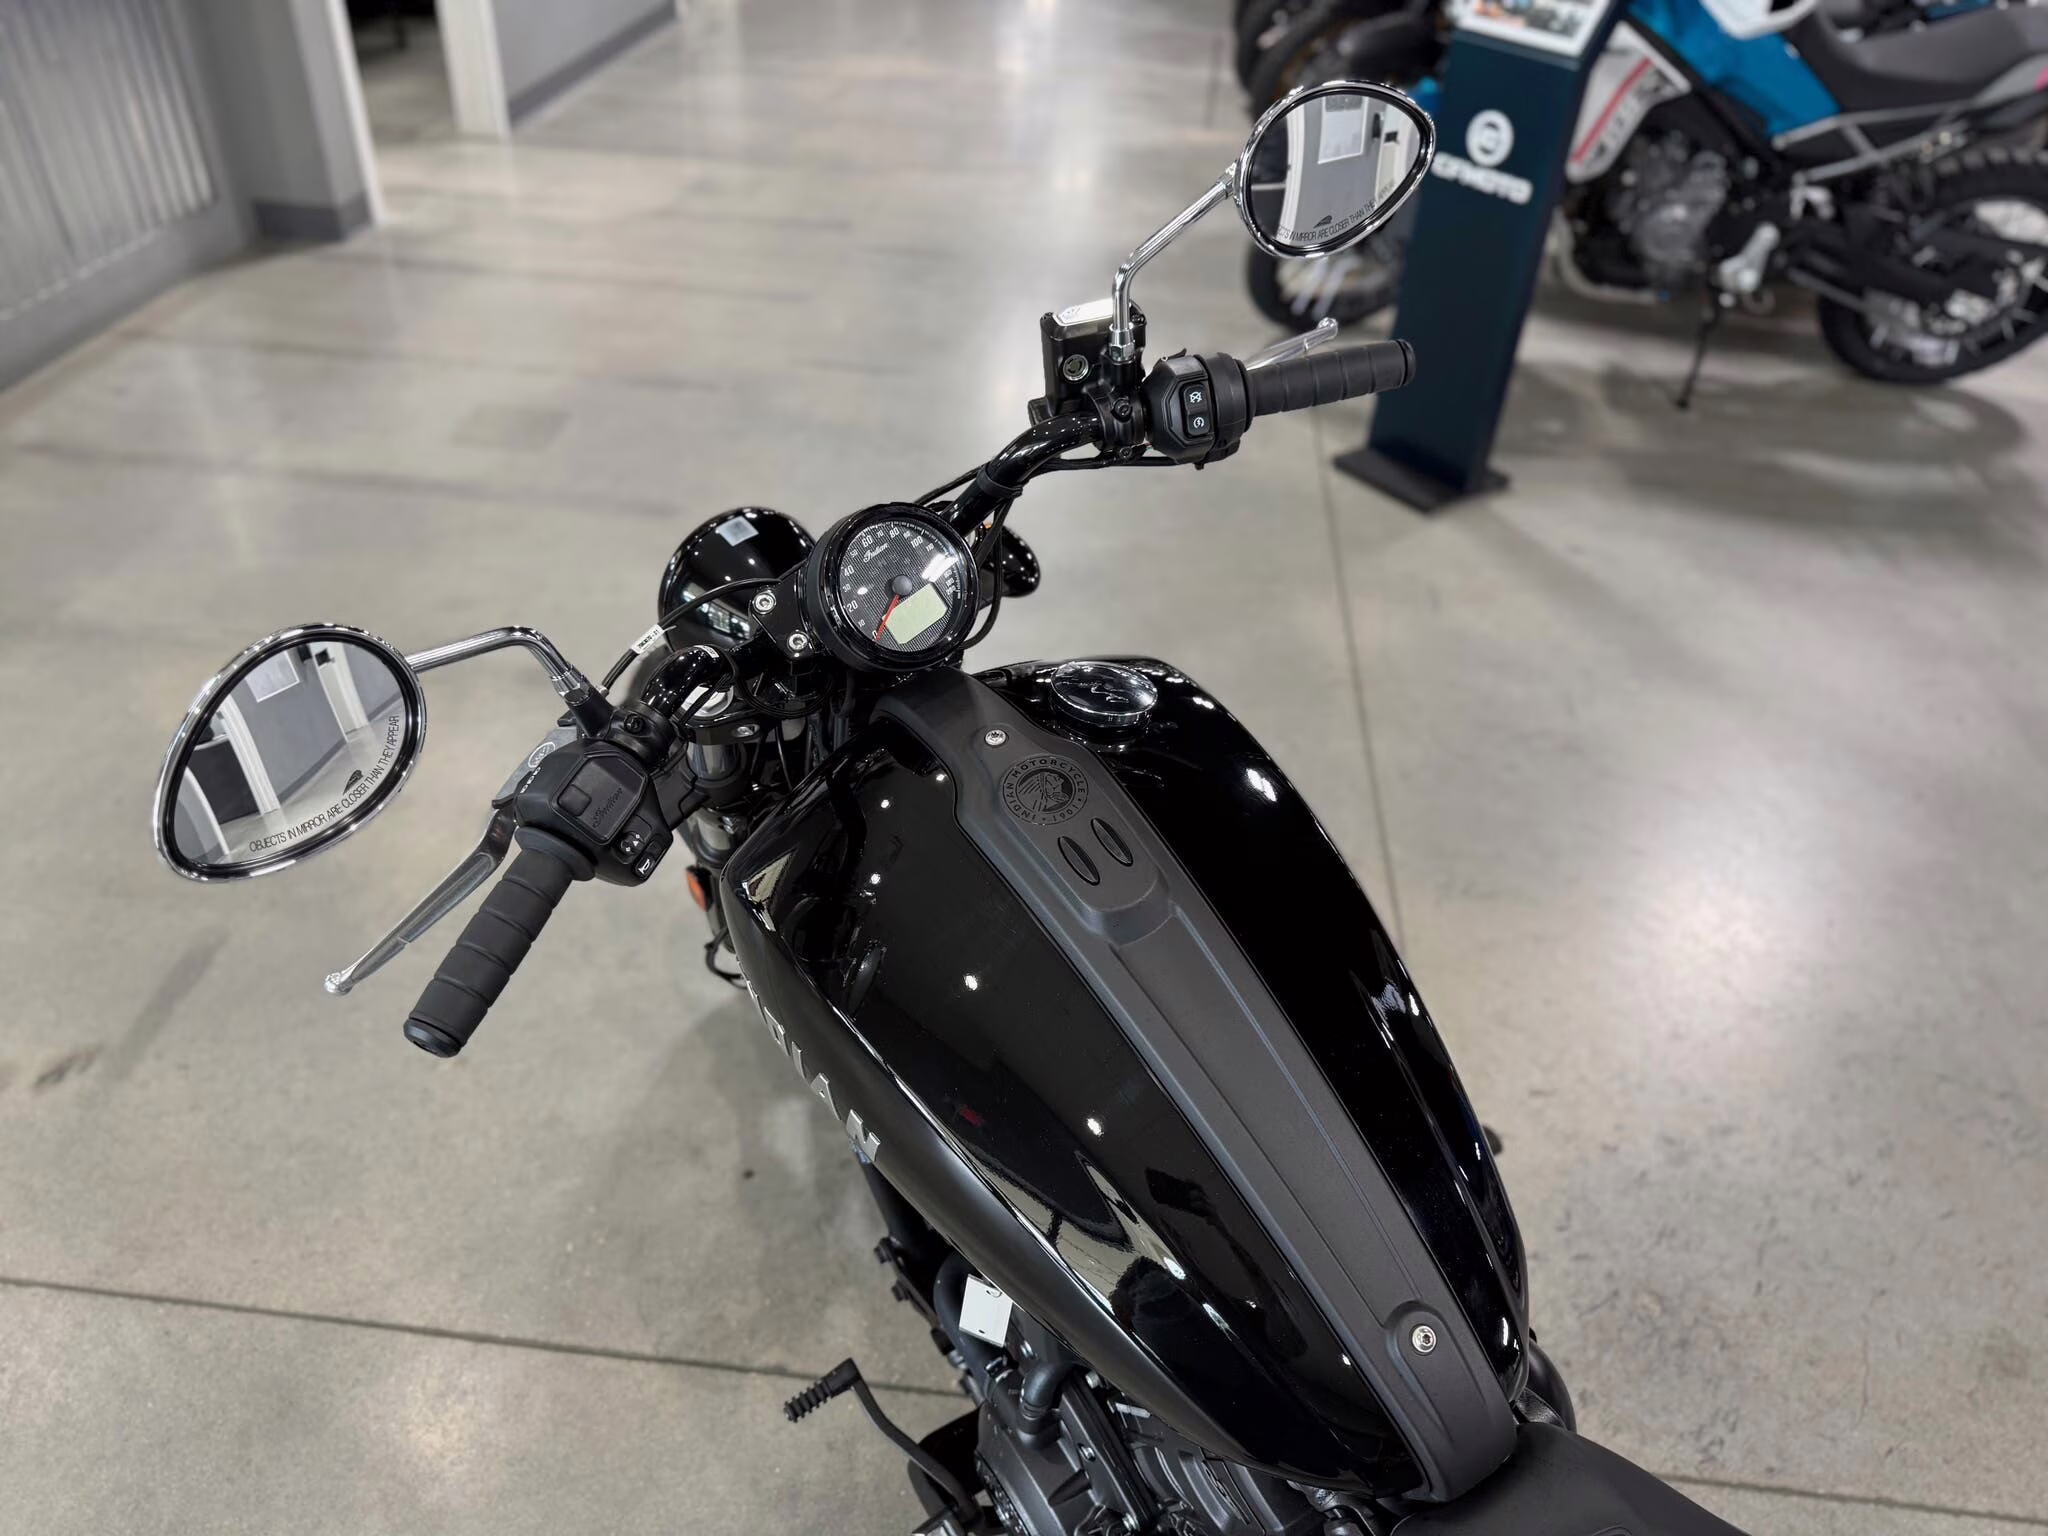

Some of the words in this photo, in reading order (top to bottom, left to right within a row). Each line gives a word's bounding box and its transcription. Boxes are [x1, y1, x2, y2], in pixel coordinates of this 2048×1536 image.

[1295, 231, 1316, 240] MIRROR
[1317, 229, 1329, 239] ARE
[1328, 219, 1349, 235] CLOSER
[1348, 210, 1364, 225] THAN
[876, 530, 884, 538] 70
[890, 527, 899, 538] 80
[862, 535, 873, 547] 60
[911, 536, 923, 548] 100
[850, 549, 857, 558] 50
[863, 543, 888, 563] Indian
[844, 565, 854, 576] 40
[842, 584, 850, 592] 30
[847, 600, 858, 612] 20
[858, 619, 866, 627] 10
[1012, 758, 1086, 793] MOTORCYCLE
[249, 832, 287, 852] OBJECTS
[288, 829, 297, 840] IN
[295, 813, 328, 837] MIRROR
[326, 804, 343, 822] ARE
[341, 782, 370, 808] CLOSER
[366, 766, 385, 791] THAN
[378, 747, 393, 770] THEY
[387, 715, 399, 746] APPEAR
[1005, 782, 1036, 820] INDIAN
[1053, 803, 1080, 822] 1901
